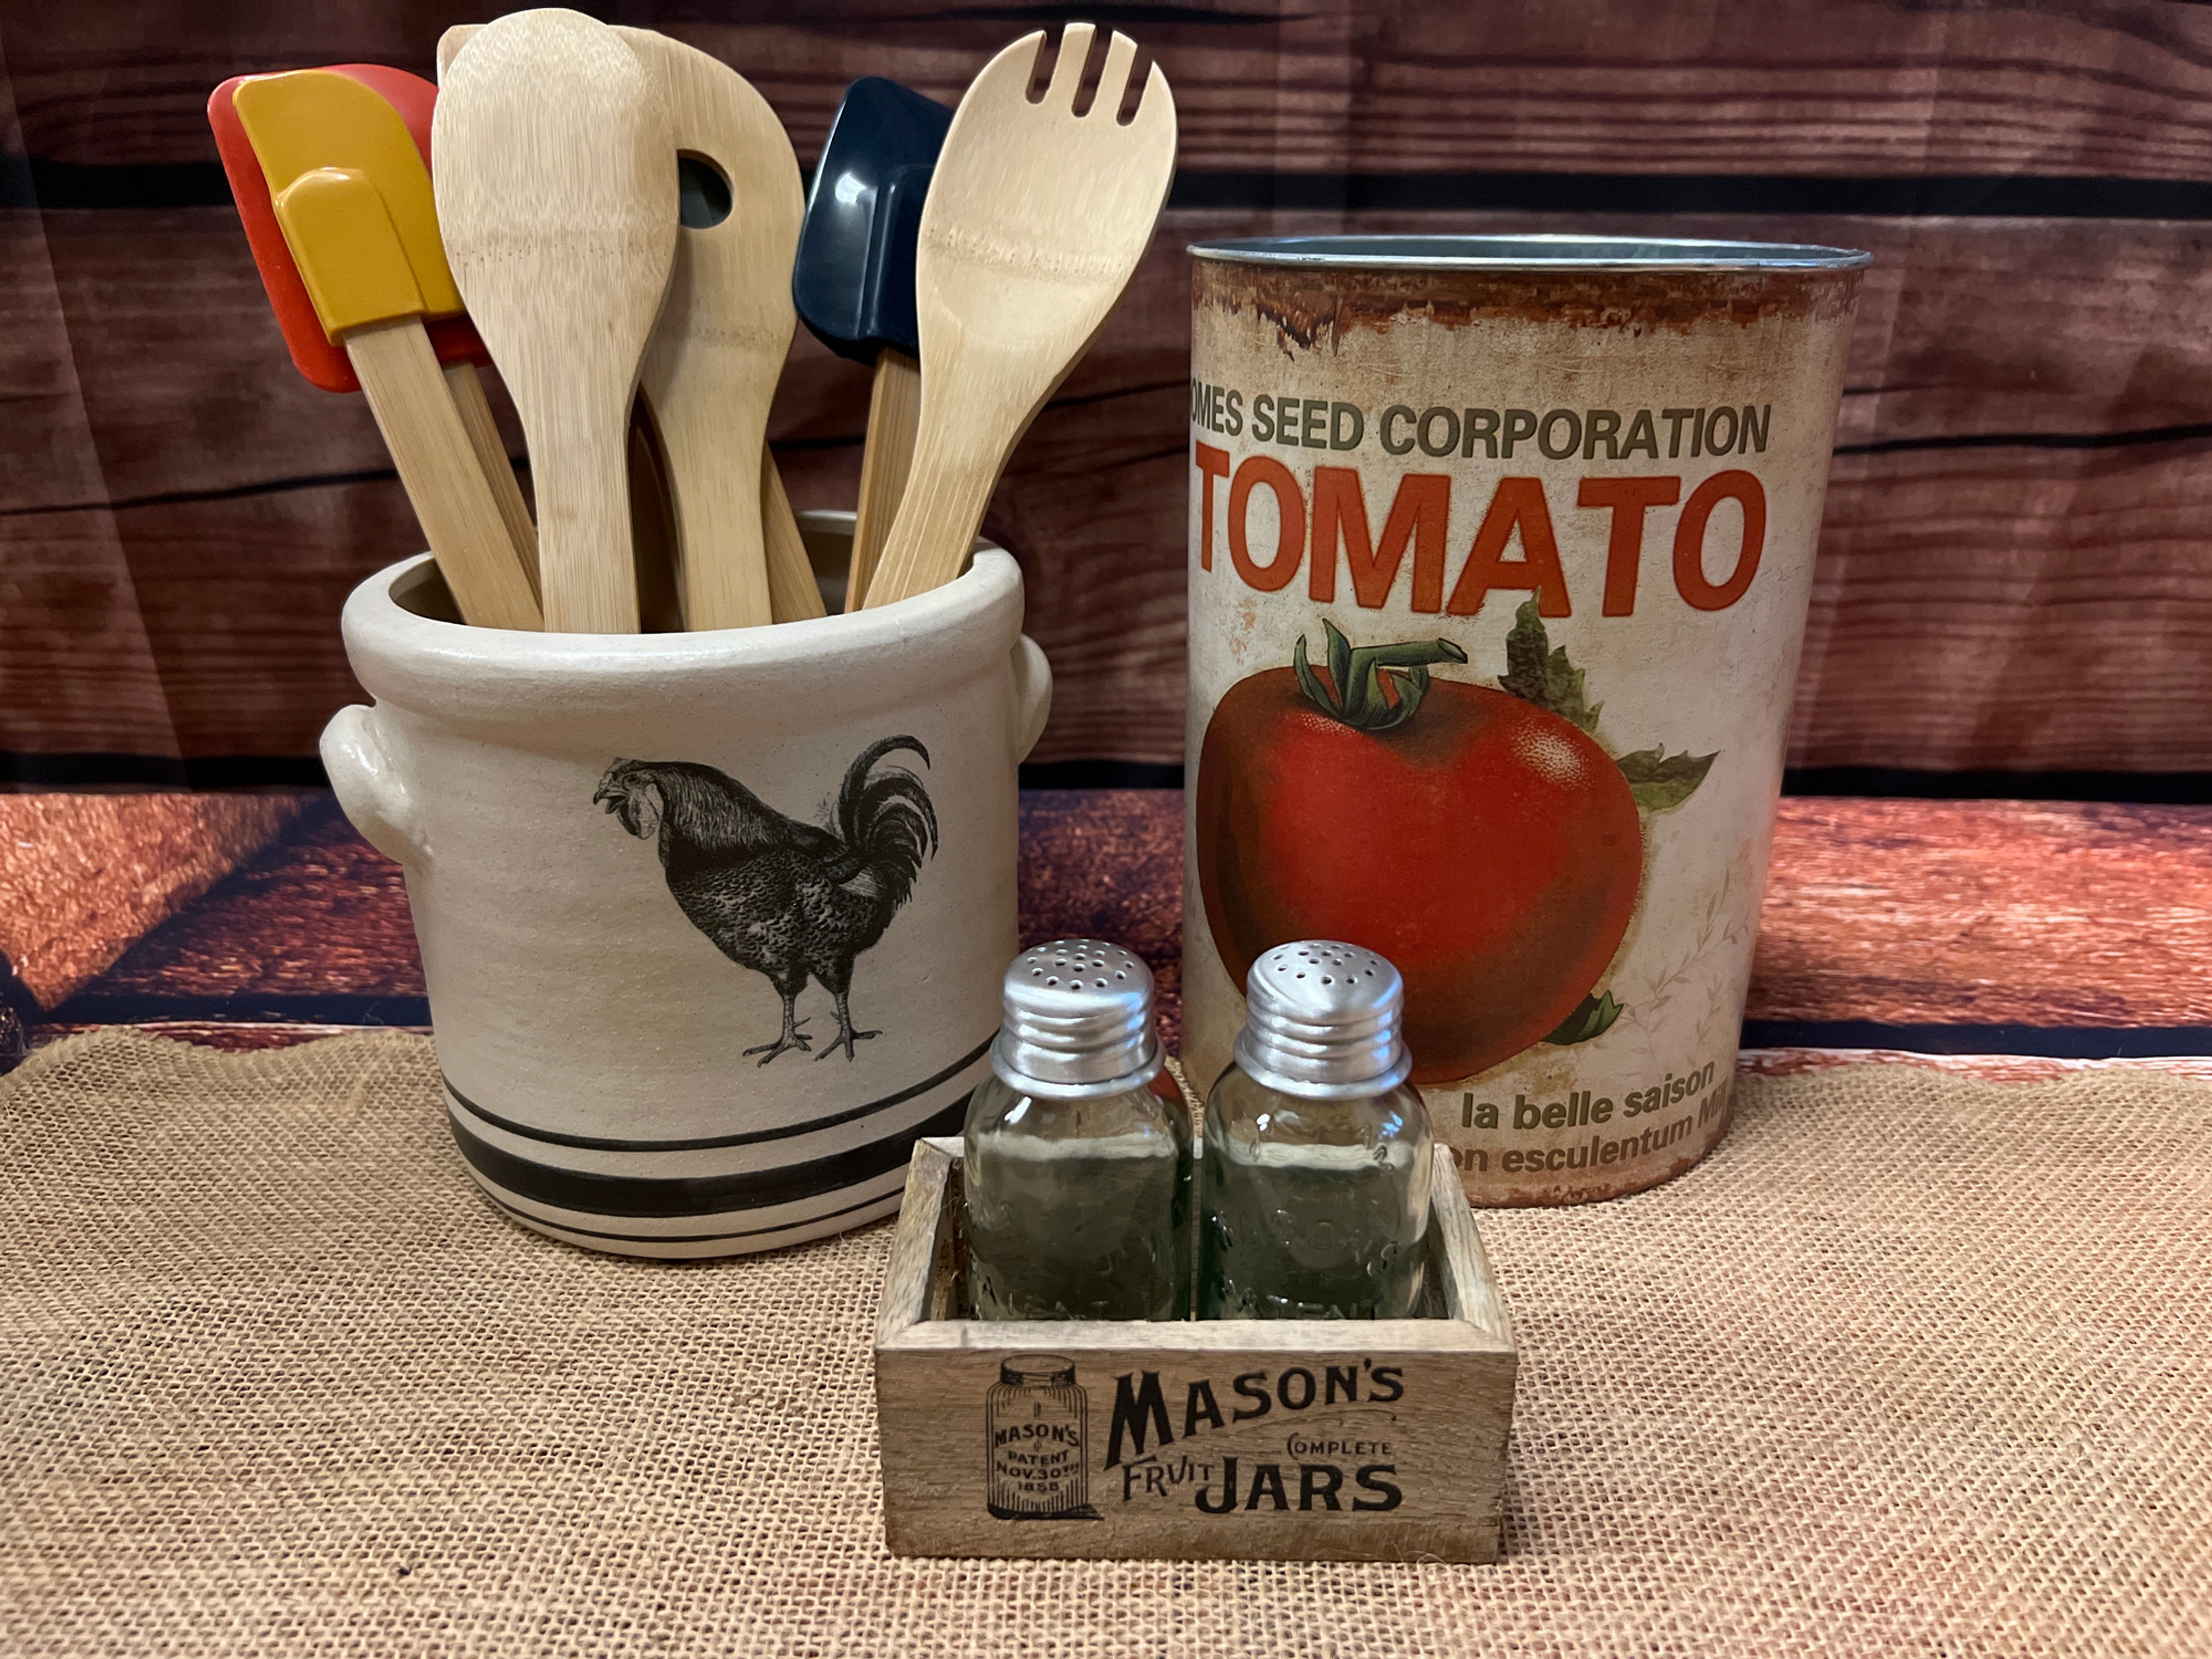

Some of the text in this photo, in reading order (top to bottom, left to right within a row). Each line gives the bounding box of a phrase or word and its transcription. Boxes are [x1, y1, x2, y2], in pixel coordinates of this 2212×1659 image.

[1252, 394, 1365, 452] SEED
[1379, 404, 1771, 460] CORPORATION
[1195, 440, 1768, 619] TOMATO
[1462, 1060, 1715, 1130] la belle saison
[1501, 1115, 1693, 1173] esculentum
[995, 1423, 1079, 1448] MASON'S
[1103, 1357, 1404, 1472] MASON'S
[1008, 1449, 1069, 1466] PATENT
[1286, 1432, 1392, 1460] COMPLETE
[1122, 1454, 1403, 1514] FRUIT JARS
